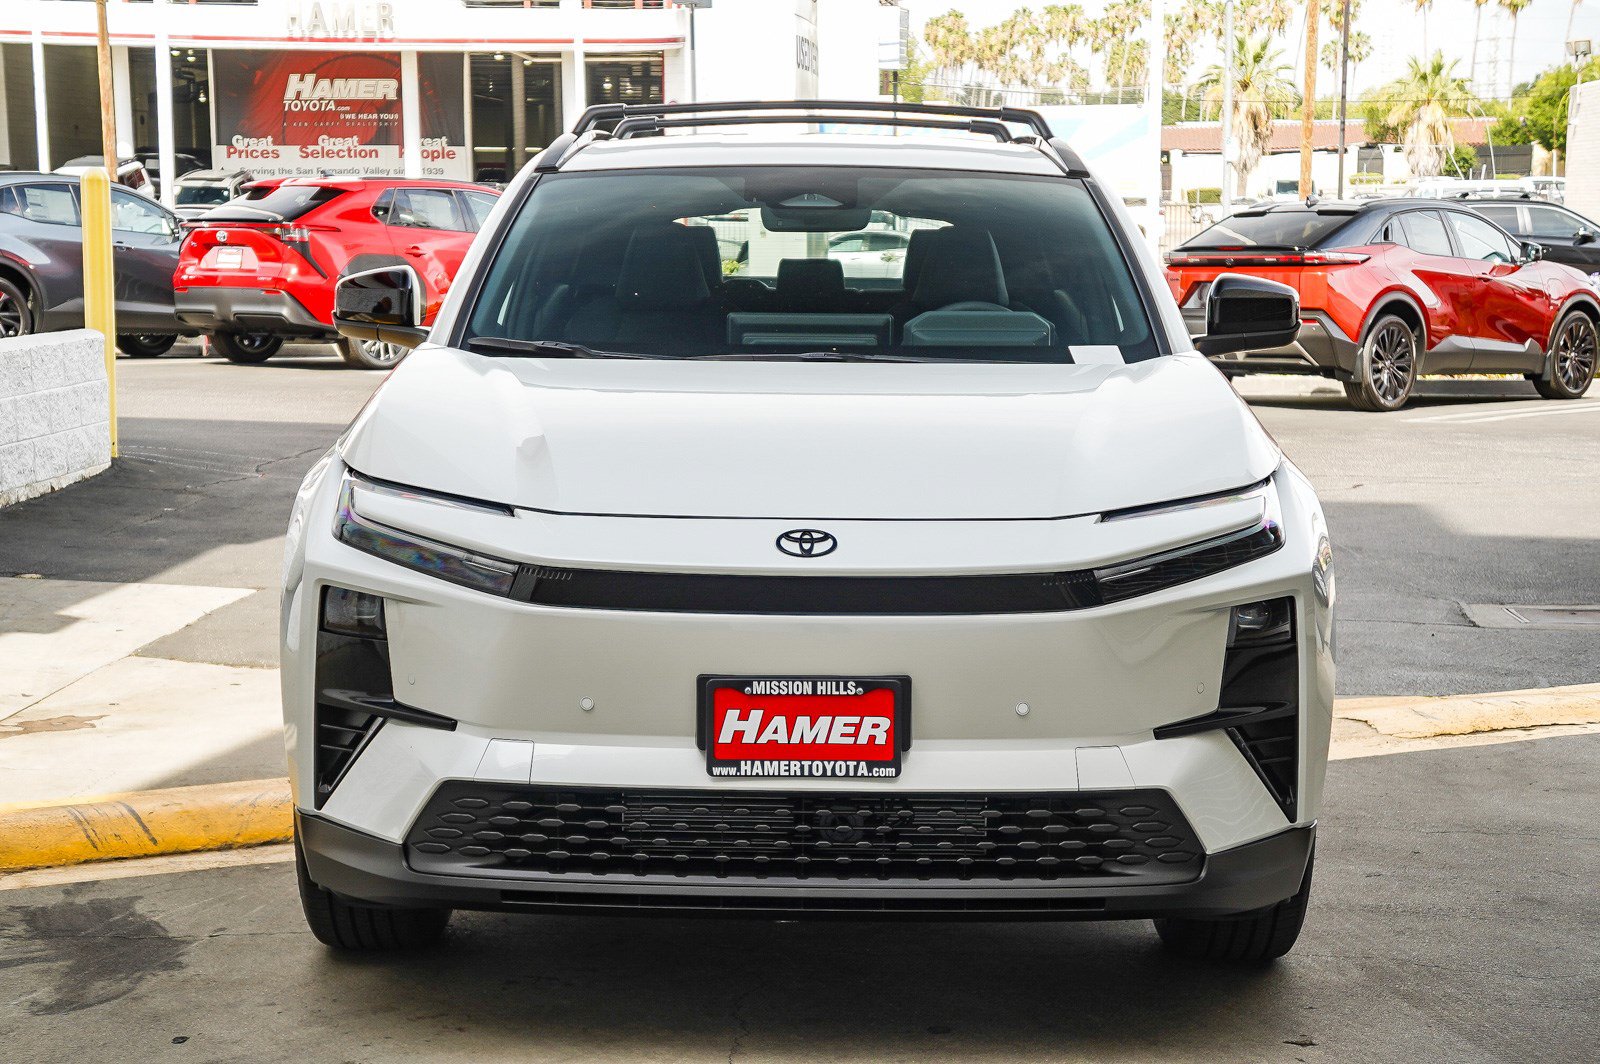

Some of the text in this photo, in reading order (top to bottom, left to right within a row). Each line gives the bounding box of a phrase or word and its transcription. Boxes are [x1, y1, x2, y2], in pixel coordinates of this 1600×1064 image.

[287, 1, 395, 38] HAMER
[283, 74, 399, 100] HAMER
[231, 134, 448, 147] Great Great reat
[226, 146, 280, 159] Prices
[299, 146, 378, 159] Selection
[240, 167, 275, 176] rving
[278, 167, 293, 175] the
[296, 167, 313, 175] San
[316, 167, 360, 175] Fnando
[363, 167, 391, 176] Valley
[421, 167, 444, 175] 1939
[752, 681, 856, 695] MISSION HILLS
[717, 709, 891, 745] HAMER
[712, 761, 896, 777] www.HAMERTOYOTA.com
